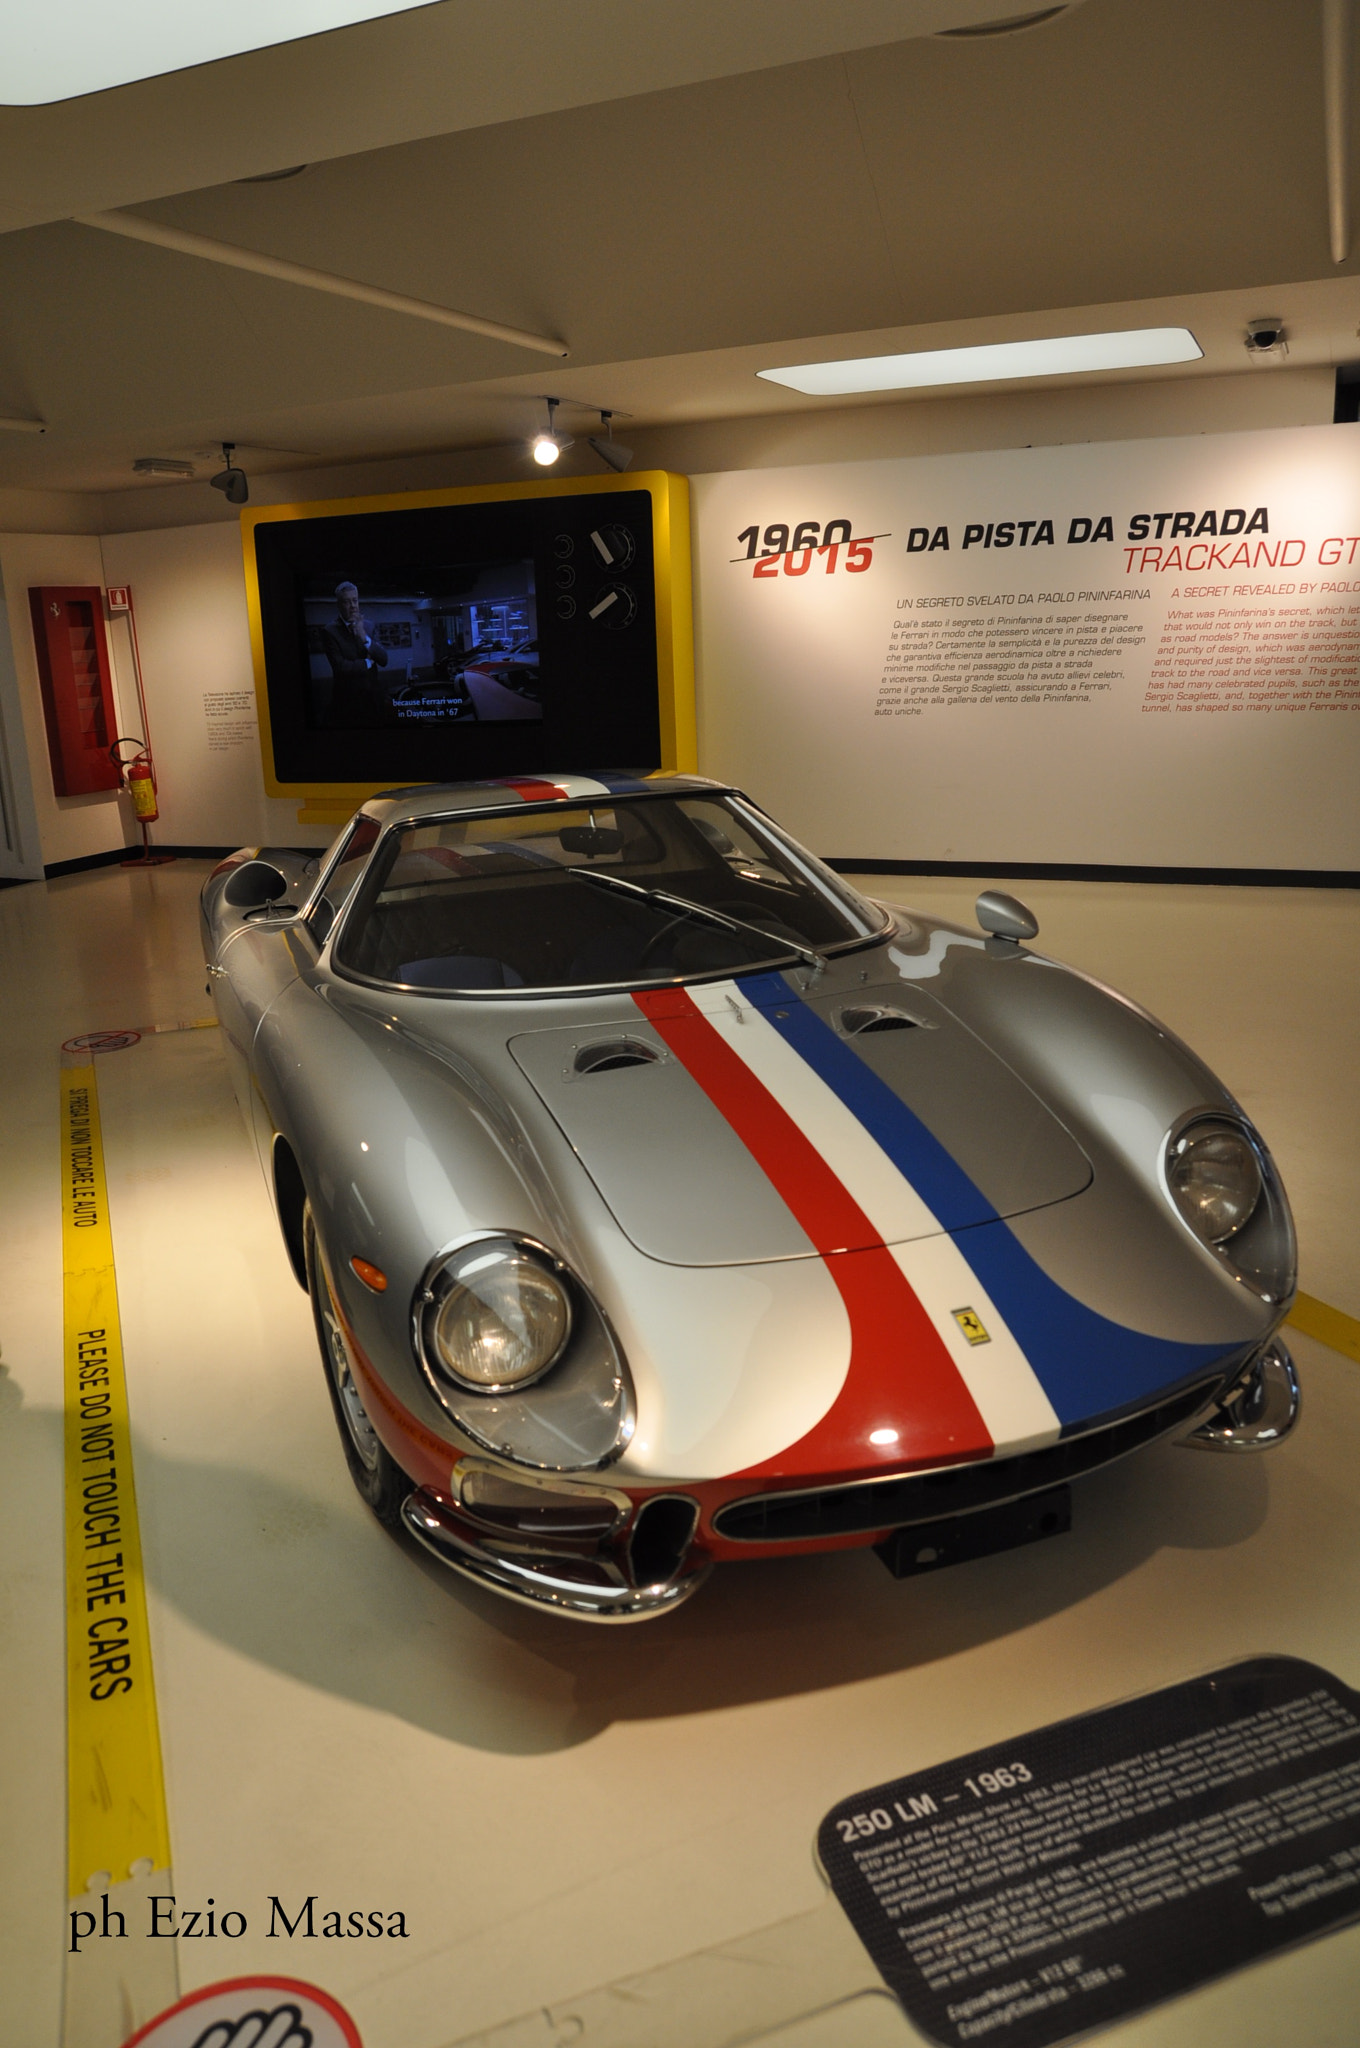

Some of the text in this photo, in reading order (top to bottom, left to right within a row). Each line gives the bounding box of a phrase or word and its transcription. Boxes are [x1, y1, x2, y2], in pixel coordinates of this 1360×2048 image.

[906, 507, 1270, 553] DA PISTA DA STRADA
[737, 519, 852, 559] 1960
[753, 537, 874, 578] 2015
[1123, 539, 1306, 574] TRACKAND
[1171, 588, 1179, 598] A
[1184, 586, 1230, 597] SECRET
[1233, 584, 1295, 596] REVEALED
[1299, 583, 1317, 593] BY
[897, 589, 1150, 609] UN SEGRETO SVELATO DA PAOLO PININFARINA
[1168, 610, 1193, 619] What
[1218, 608, 1275, 617] Pininfarina's
[1317, 606, 1344, 615] which
[921, 620, 942, 628] stato
[952, 619, 984, 628] segreto
[997, 616, 1043, 624] Pininfarina
[1056, 616, 1082, 624] saper
[1084, 614, 1128, 624] disegnare
[1164, 623, 1183, 631] that
[1186, 621, 1213, 630] would
[1234, 620, 1253, 631] only
[1256, 620, 1271, 628] win
[1290, 619, 1305, 628] the
[1341, 618, 1357, 626] but
[901, 624, 1143, 639] Ferrari modo che potessero vincere pista piacere
[1174, 634, 1197, 642] road
[1199, 632, 1239, 641] models?
[1243, 632, 1259, 640] The
[901, 641, 933, 650] strada?
[936, 641, 985, 649] Certamente
[1063, 638, 1097, 647] purezza
[1117, 635, 1145, 646] design
[904, 652, 941, 663] garantiva
[944, 652, 982, 660] efficienza
[985, 650, 1043, 659] aerodinamica
[1046, 649, 1066, 657] oltre
[1077, 648, 1122, 656] richiedere
[1157, 646, 1175, 654] and
[1177, 645, 1204, 656] purity
[1218, 644, 1250, 655] design,
[1256, 643, 1282, 652] which
[884, 659, 1093, 672] minime modifiche passaggio pista strada
[1154, 656, 1295, 667] and required just the slightest
[932, 674, 962, 682] Questa
[964, 673, 994, 683] grande
[997, 672, 1024, 681] scuola
[1067, 671, 1090, 679] allievi
[1151, 669, 1175, 677] track
[1190, 669, 1205, 677] the
[1208, 668, 1230, 676] road
[1233, 668, 1251, 676] and
[1254, 667, 1271, 676] vice
[1309, 666, 1328, 675] This
[1330, 667, 1358, 677] great
[910, 685, 939, 695] grande
[942, 683, 969, 694] Sergio
[1015, 683, 1068, 691] assicurando
[1079, 682, 1111, 691] Ferrari,
[1148, 681, 1164, 689] has
[1167, 681, 1185, 689] had
[1187, 682, 1213, 690] many
[1215, 679, 1265, 688] celebrated
[1302, 679, 1325, 687] such
[1343, 678, 1359, 687] the
[392, 698, 420, 706] because
[421, 697, 446, 705] Ferrari
[876, 697, 901, 707] grazie
[904, 696, 928, 704] anche
[931, 696, 945, 704] alla
[1021, 694, 1040, 702] della
[1043, 693, 1091, 702] Pininfarina,
[1145, 692, 1174, 703] Sergio
[1249, 691, 1290, 701] together
[1293, 691, 1312, 699] with
[1315, 690, 1331, 699] the
[398, 709, 405, 717] in
[406, 709, 436, 719] Daytona
[437, 708, 444, 716] in
[874, 707, 892, 715] auto
[1176, 704, 1192, 712] has
[1195, 703, 1229, 713] shaped
[1246, 704, 1272, 713] many
[1274, 703, 1306, 712] unique
[1309, 702, 1348, 711] Ferraris
[69, 1095, 89, 1117] PREGA
[70, 1118, 90, 1126] DI
[70, 1128, 91, 1145] NON
[71, 1146, 94, 1184] TOCCARE
[72, 1186, 95, 1198] LE
[73, 1201, 97, 1227] AUTO
[78, 1329, 133, 1701] PLEASE DO NOT TOUCH THE CARS
[836, 1762, 1033, 1843] 250 LM 1963
